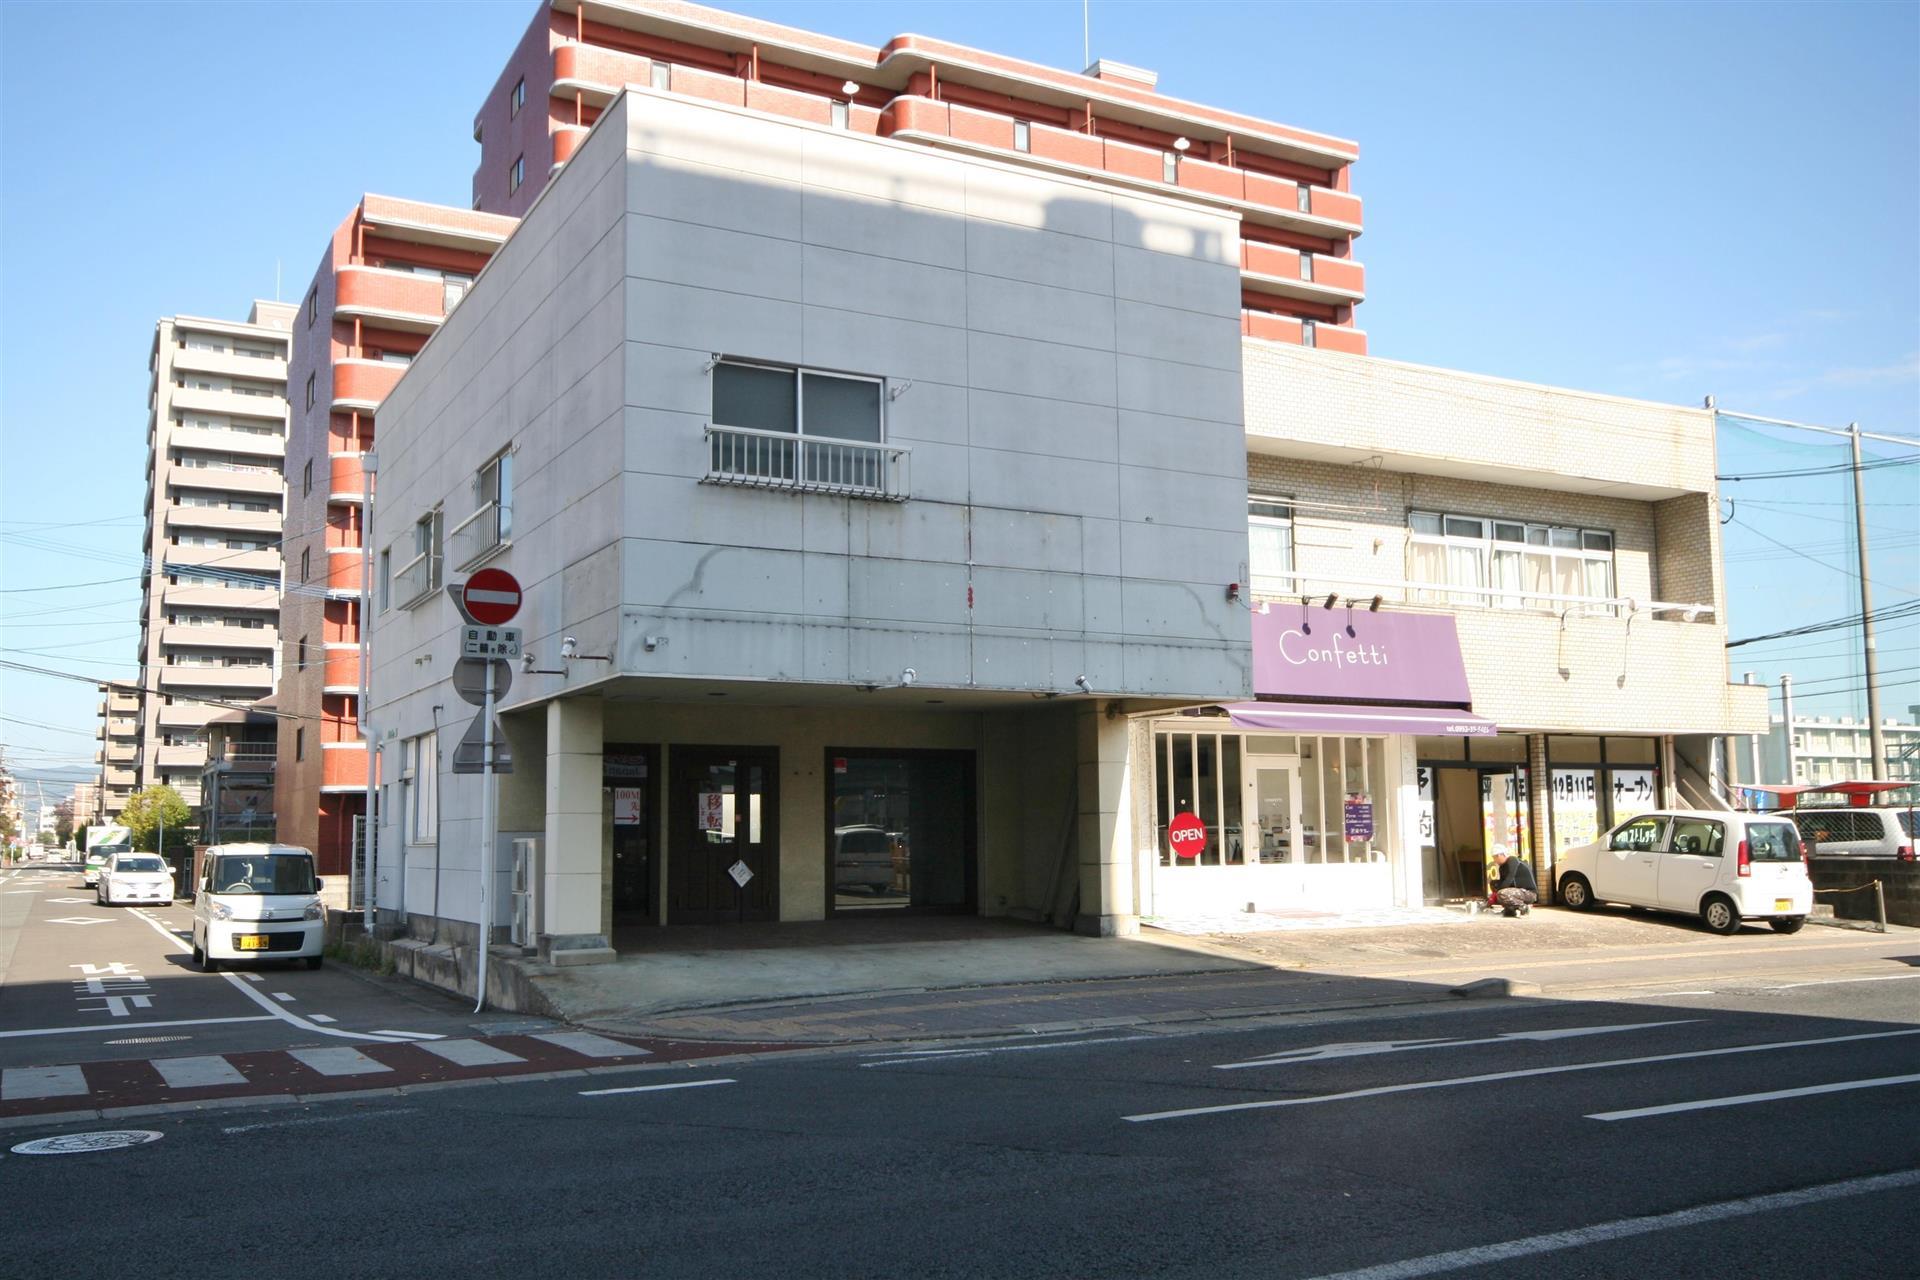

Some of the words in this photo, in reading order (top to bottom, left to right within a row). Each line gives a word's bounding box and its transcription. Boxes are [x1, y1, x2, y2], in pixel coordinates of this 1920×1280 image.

[468, 630, 515, 641] 自動車
[1279, 629, 1388, 669] Confetti
[1553, 774, 1595, 802] 12月11日
[1614, 775, 1653, 803] オープン
[1172, 828, 1204, 843] OPEN
